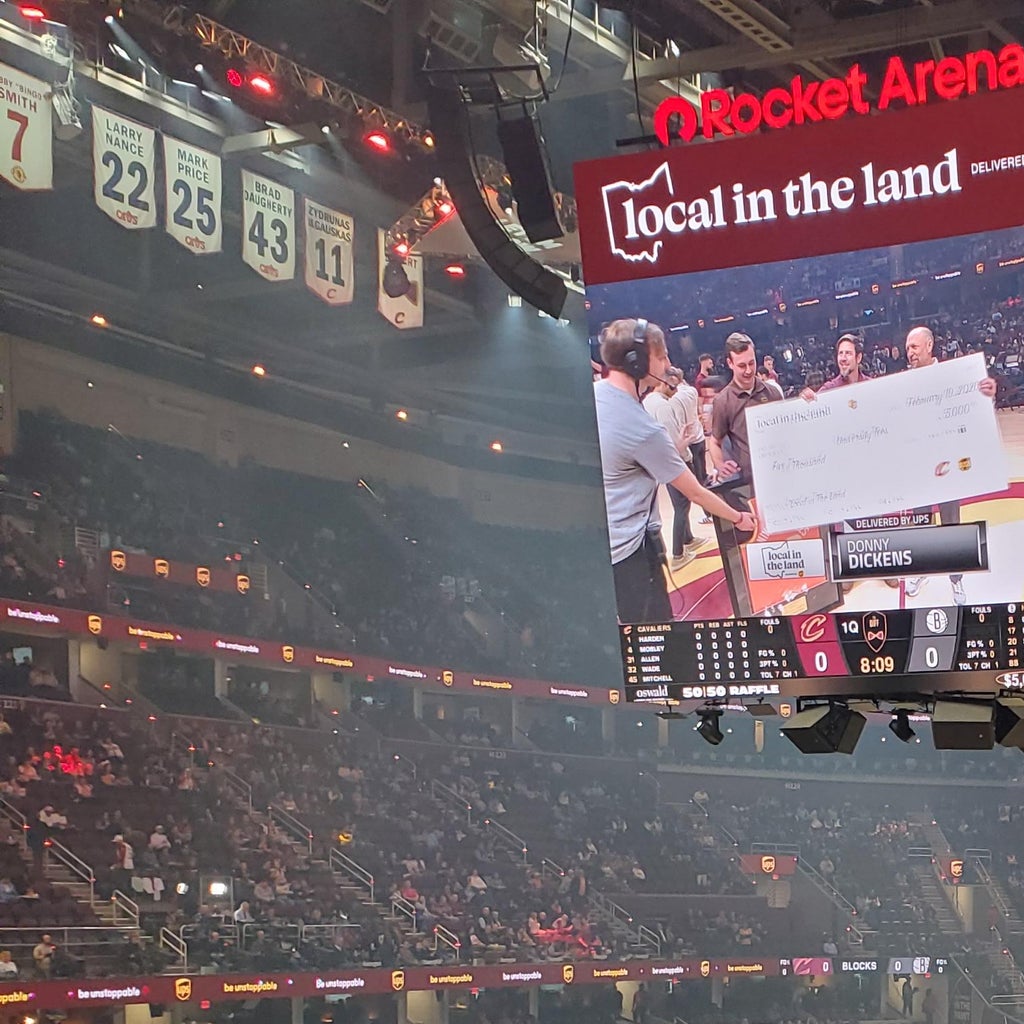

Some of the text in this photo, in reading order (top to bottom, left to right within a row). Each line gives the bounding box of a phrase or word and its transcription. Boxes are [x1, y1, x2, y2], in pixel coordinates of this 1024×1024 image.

[702, 63, 870, 139] Rocket
[7, 109, 29, 162] 7
[105, 118, 143, 142] LARRY
[105, 133, 144, 158] NANCE
[177, 148, 209, 170] MARK
[177, 162, 209, 184] PRICE
[102, 150, 150, 212] 22
[255, 181, 281, 200] BRAD
[622, 186, 727, 240] local
[732, 183, 776, 223] in
[784, 171, 856, 218] the
[862, 148, 962, 206] land
[172, 178, 217, 236] 25
[308, 205, 350, 230] ZYDRUNAS
[248, 211, 289, 264] 43
[315, 237, 345, 287] 11
[393, 312, 405, 324] C
[856, 514, 930, 529] DELIVERED BY UPS
[847, 538, 890, 553] DONNY
[768, 550, 802, 561] local in
[849, 550, 912, 569] DICKENS
[767, 559, 805, 570] the land
[979, 614, 985, 622] 0
[637, 625, 671, 633] CAVALIERS
[768, 626, 773, 634] 0
[841, 621, 859, 634] 1Q
[815, 651, 828, 672] 0
[860, 656, 895, 673] 8:09
[925, 647, 938, 668] 0
[636, 685, 668, 697] oswald
[730, 684, 780, 696] RAFFLE
[822, 962, 829, 972] 0
[842, 961, 877, 971] BLOCKS
[895, 961, 902, 971] 0
[325, 979, 365, 990] unstoppable
[438, 974, 473, 985] unstoppable
[78, 987, 140, 1001] be unstoppable
[223, 982, 277, 995] be unstoppable
